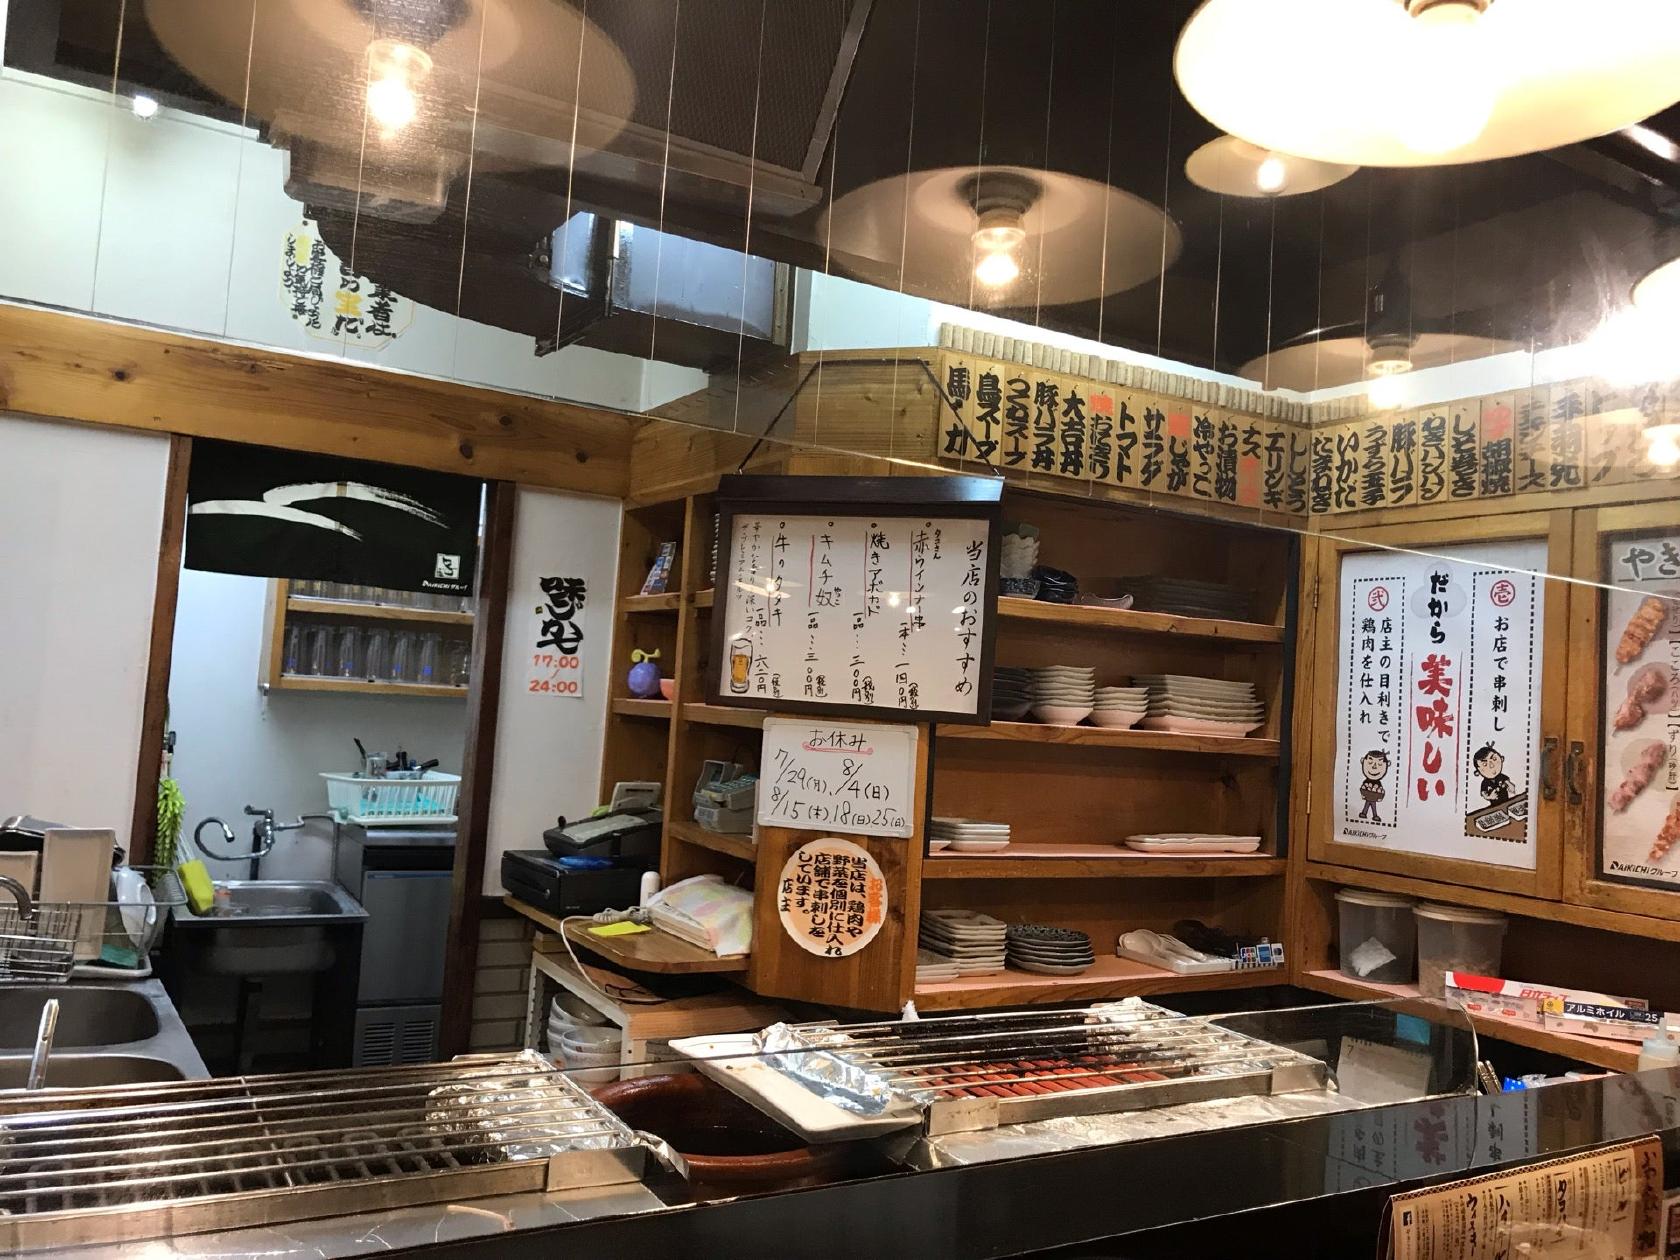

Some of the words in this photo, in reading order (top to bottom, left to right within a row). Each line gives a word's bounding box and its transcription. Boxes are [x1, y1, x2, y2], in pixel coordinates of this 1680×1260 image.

[1032, 381, 1059, 471] 豚バラ丼
[1060, 390, 1085, 476] 大吉丼
[1116, 401, 1137, 483] トマト
[1141, 407, 1165, 487] サラダ
[1192, 415, 1215, 498] 冷やっこ
[1215, 420, 1238, 501] お漬物
[1390, 420, 1416, 504] 豚バラ
[1450, 414, 1479, 498] しそ巻き
[1264, 432, 1285, 509] エリンギ
[1286, 432, 1307, 512] ししとう
[1311, 437, 1333, 513] たまねぎ
[1334, 431, 1359, 508] いかだ
[1622, 543, 1680, 578] やき
[955, 540, 983, 696] 当店のおすすめ
[1428, 570, 1450, 644] だから
[529, 679, 578, 693] 24:00
[533, 655, 579, 669] 17:00
[1359, 618, 1376, 724] 鶏肉を仕入れ
[1377, 616, 1394, 744] 店主の目利きで
[1491, 616, 1510, 732] お店で串刺し
[809, 729, 867, 751] お休み
[1416, 654, 1454, 801] 美味しい
[781, 878, 793, 912] 店主
[796, 851, 812, 914] しています。
[809, 852, 831, 937] 店舗で串刺しを
[825, 854, 851, 955] 野菜を個別に仕入れ
[846, 856, 867, 938] 当店は、鶏肉や
[1566, 1003, 1626, 1019] アルミホイル
